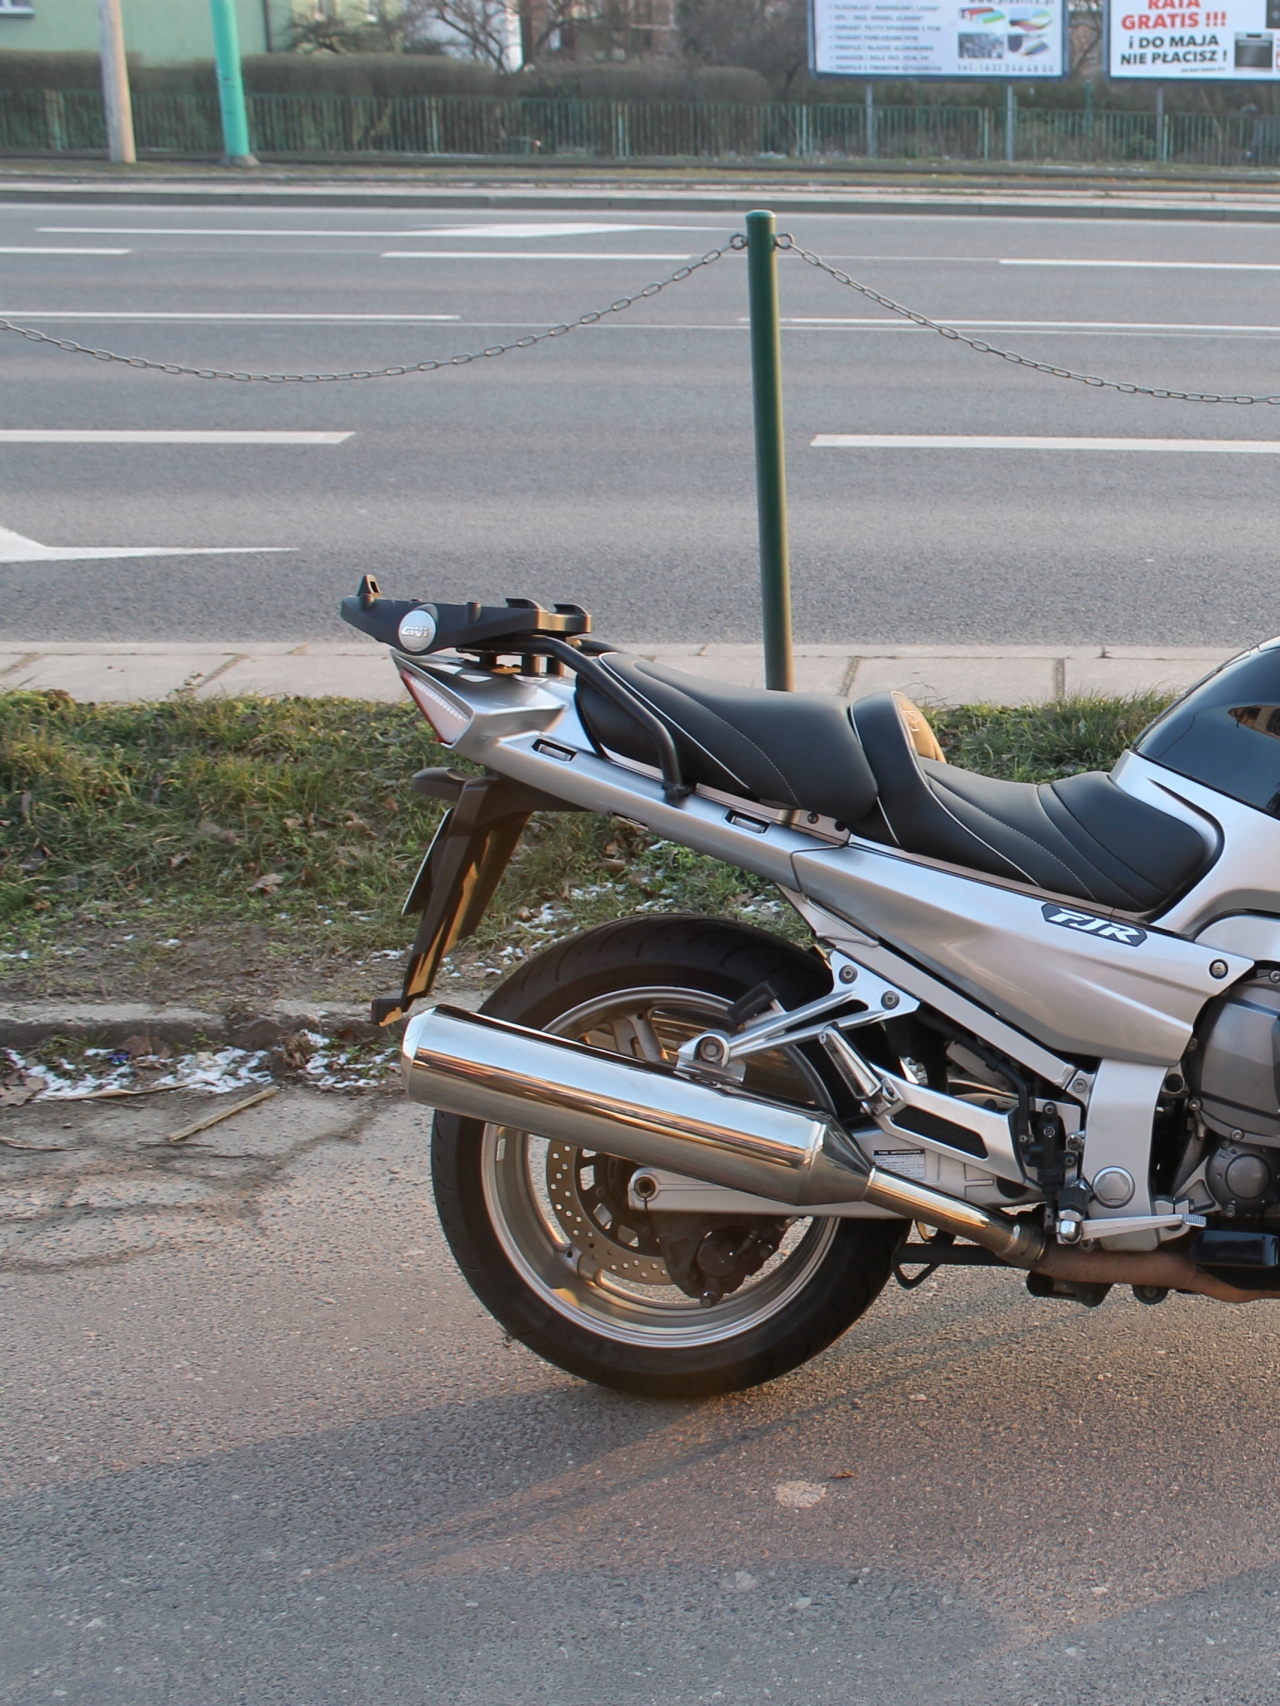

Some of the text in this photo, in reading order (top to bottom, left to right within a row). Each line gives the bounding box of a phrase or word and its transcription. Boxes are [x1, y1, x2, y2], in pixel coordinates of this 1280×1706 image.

[1121, 11, 1227, 30] GRATIS !!!
[1138, 36, 1165, 49] DO
[1169, 33, 1219, 47] MAJA
[1120, 49, 1227, 65] NIE PŁACISZ !
[1048, 907, 1140, 943] FJR
